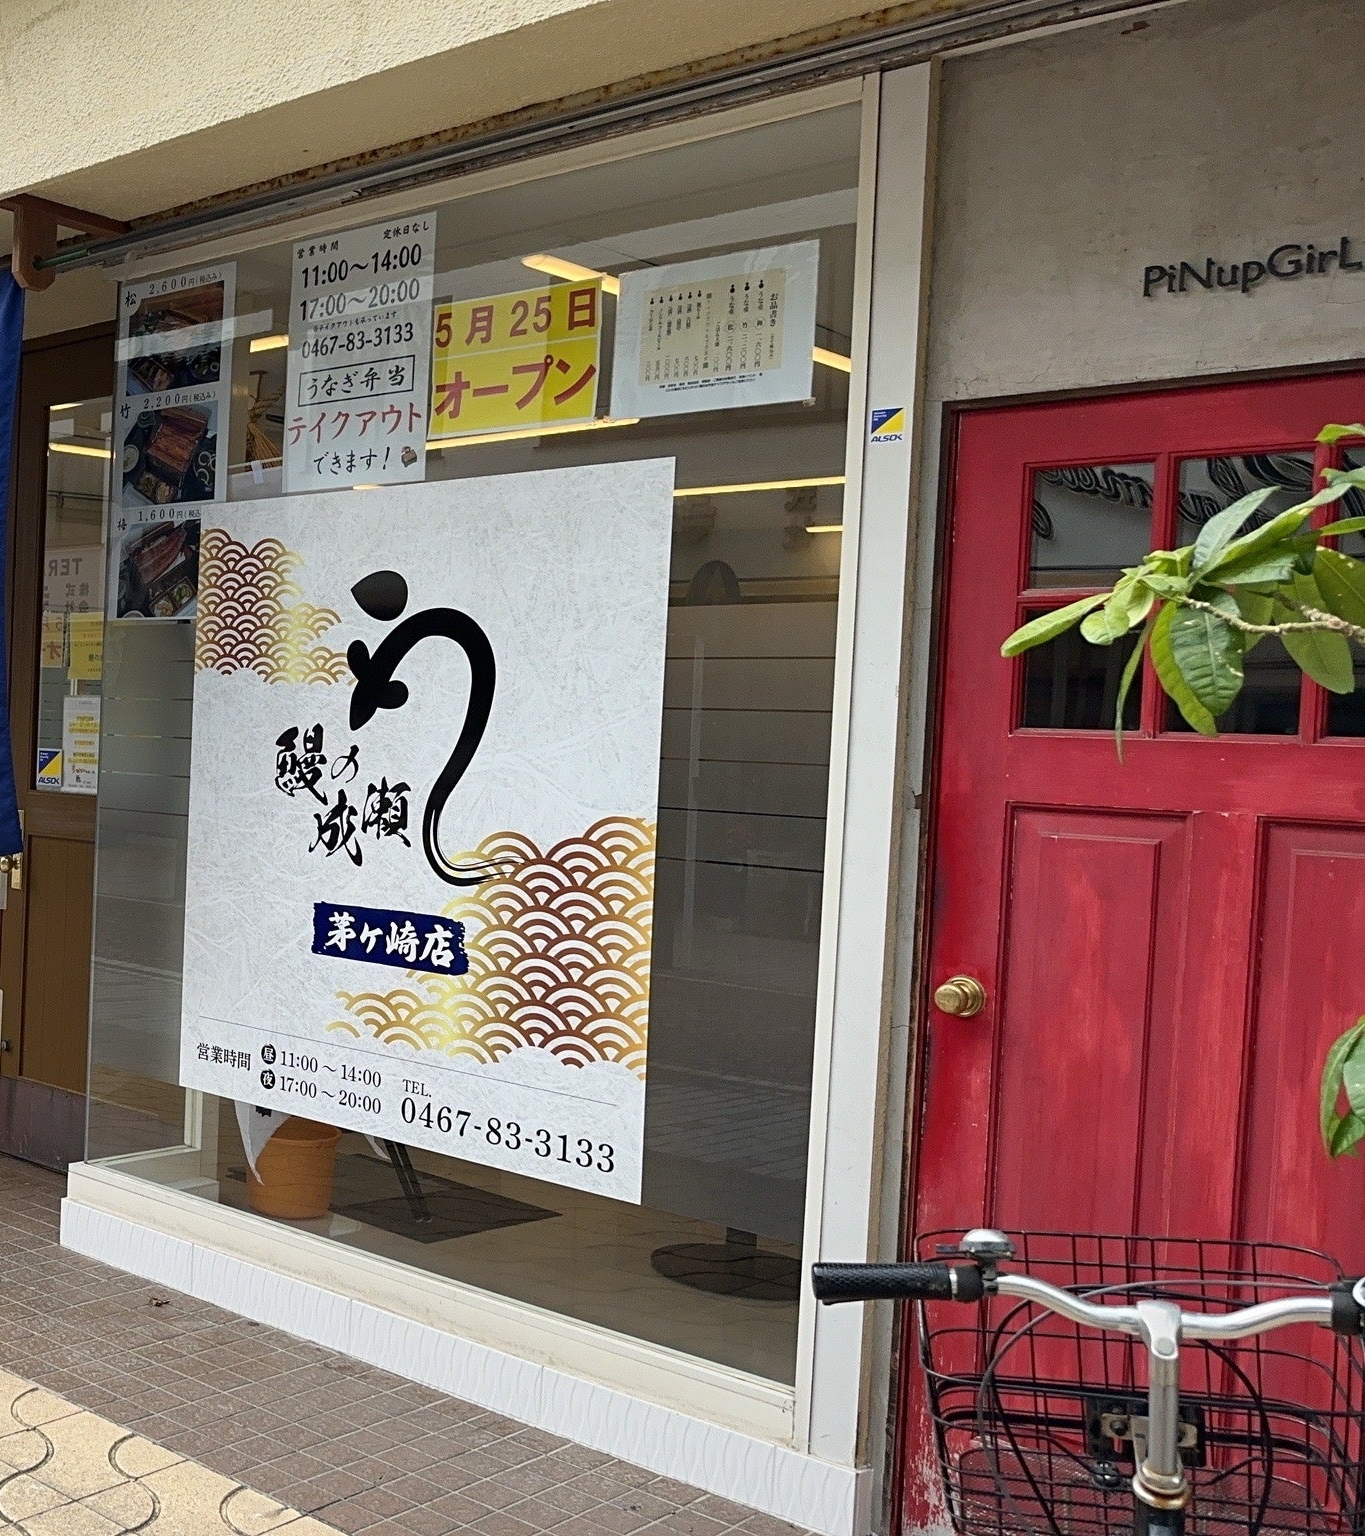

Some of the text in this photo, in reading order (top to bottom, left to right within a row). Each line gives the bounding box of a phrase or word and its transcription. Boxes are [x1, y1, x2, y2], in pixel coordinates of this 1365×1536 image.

[382, 221, 430, 240] 定休日なし
[296, 240, 340, 260] 営業時間
[301, 243, 422, 290] 11:00～14:00
[124, 290, 138, 308] 松
[435, 288, 597, 348] 5月25日
[301, 322, 414, 360] 0467-83-3133
[306, 364, 407, 400] うなぎ弁当
[435, 355, 597, 420] オープン
[119, 403, 132, 420] 竹
[288, 402, 422, 446] テイクアウト
[870, 434, 902, 443] ALSOK
[313, 446, 391, 476] できます！
[38, 776, 60, 785] ALSOK
[196, 1042, 251, 1073] 営業時間
[261, 1044, 277, 1065] 昼
[260, 1069, 276, 1090] 夜
[402, 1077, 433, 1099] TEL.
[400, 1096, 616, 1174] 0467-83-3133
